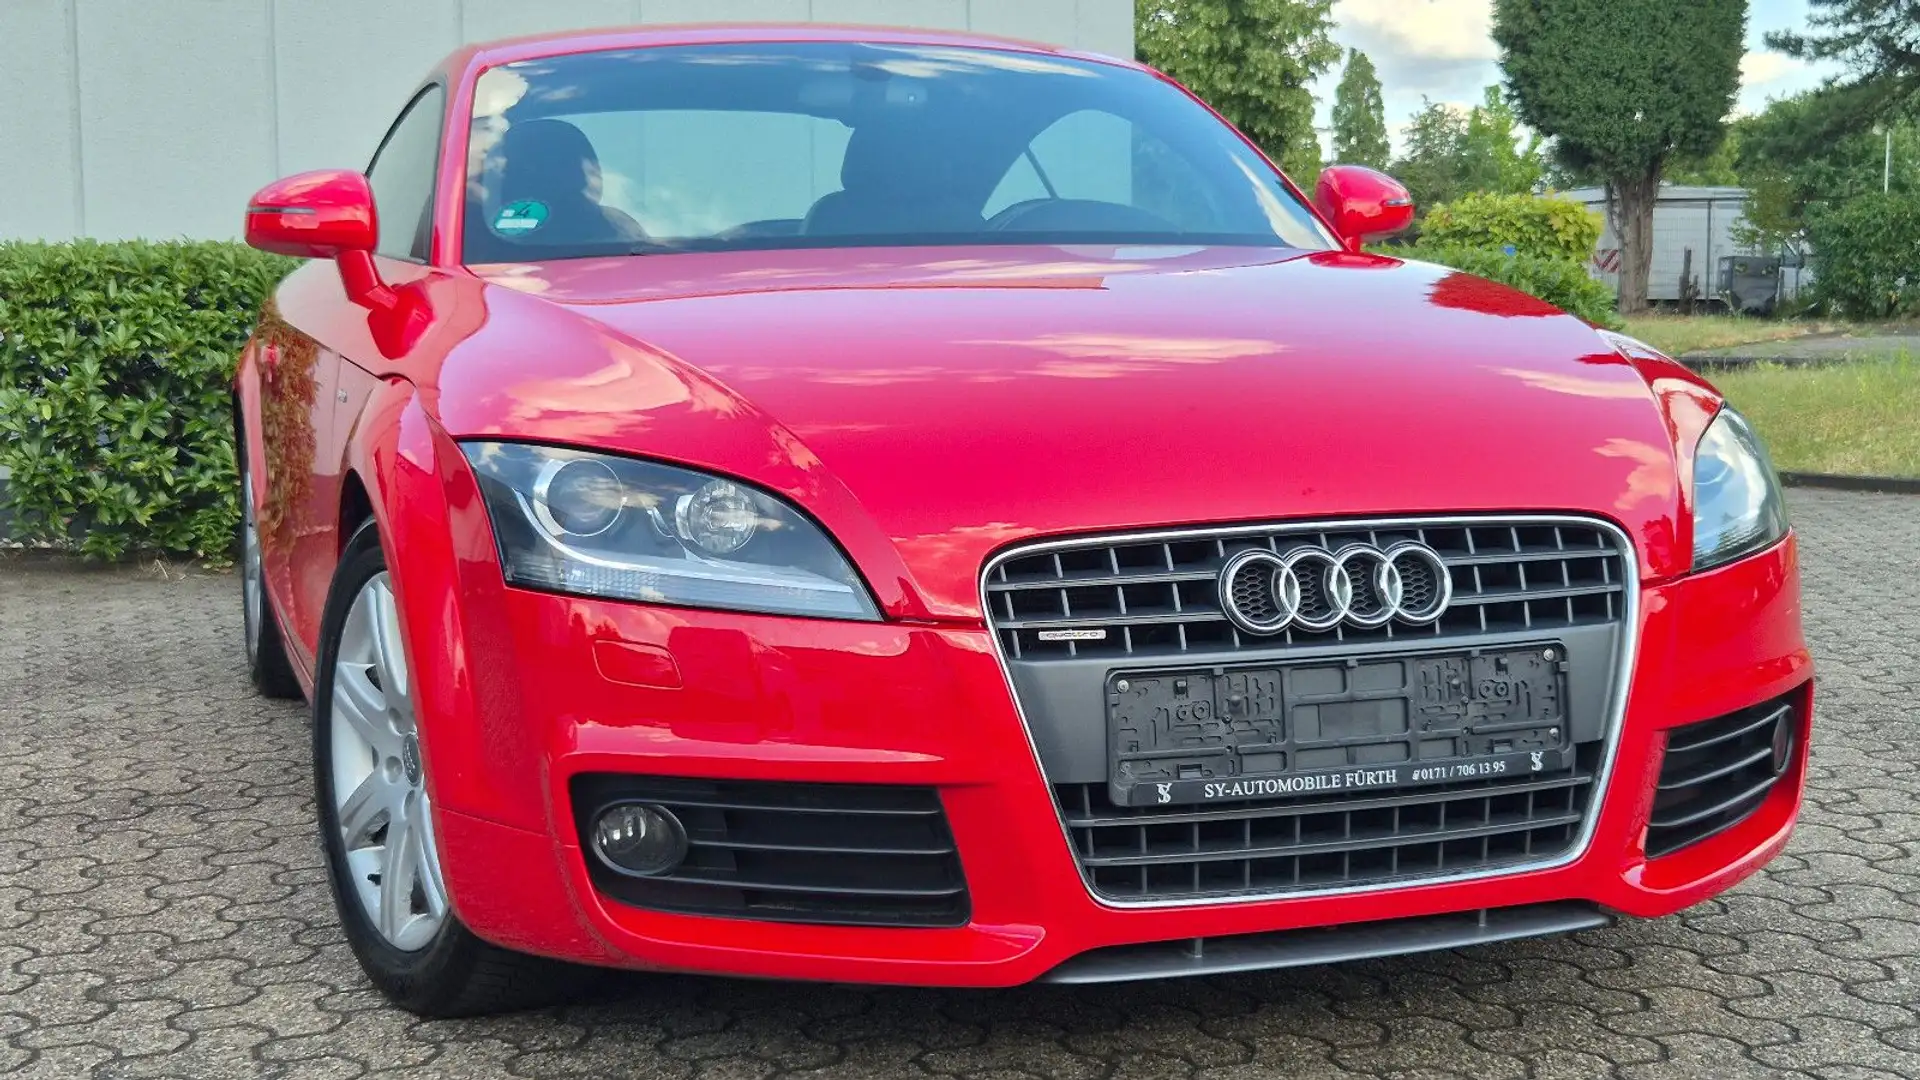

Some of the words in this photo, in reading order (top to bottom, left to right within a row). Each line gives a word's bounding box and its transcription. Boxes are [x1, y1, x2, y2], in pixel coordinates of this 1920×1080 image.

[1457, 763, 1475, 776] 706
[1478, 762, 1490, 774] 13
[1493, 760, 1506, 773] 95
[1204, 774, 1341, 798] SY-AUTOMOBILE
[1345, 769, 1397, 787] FÜRTH
